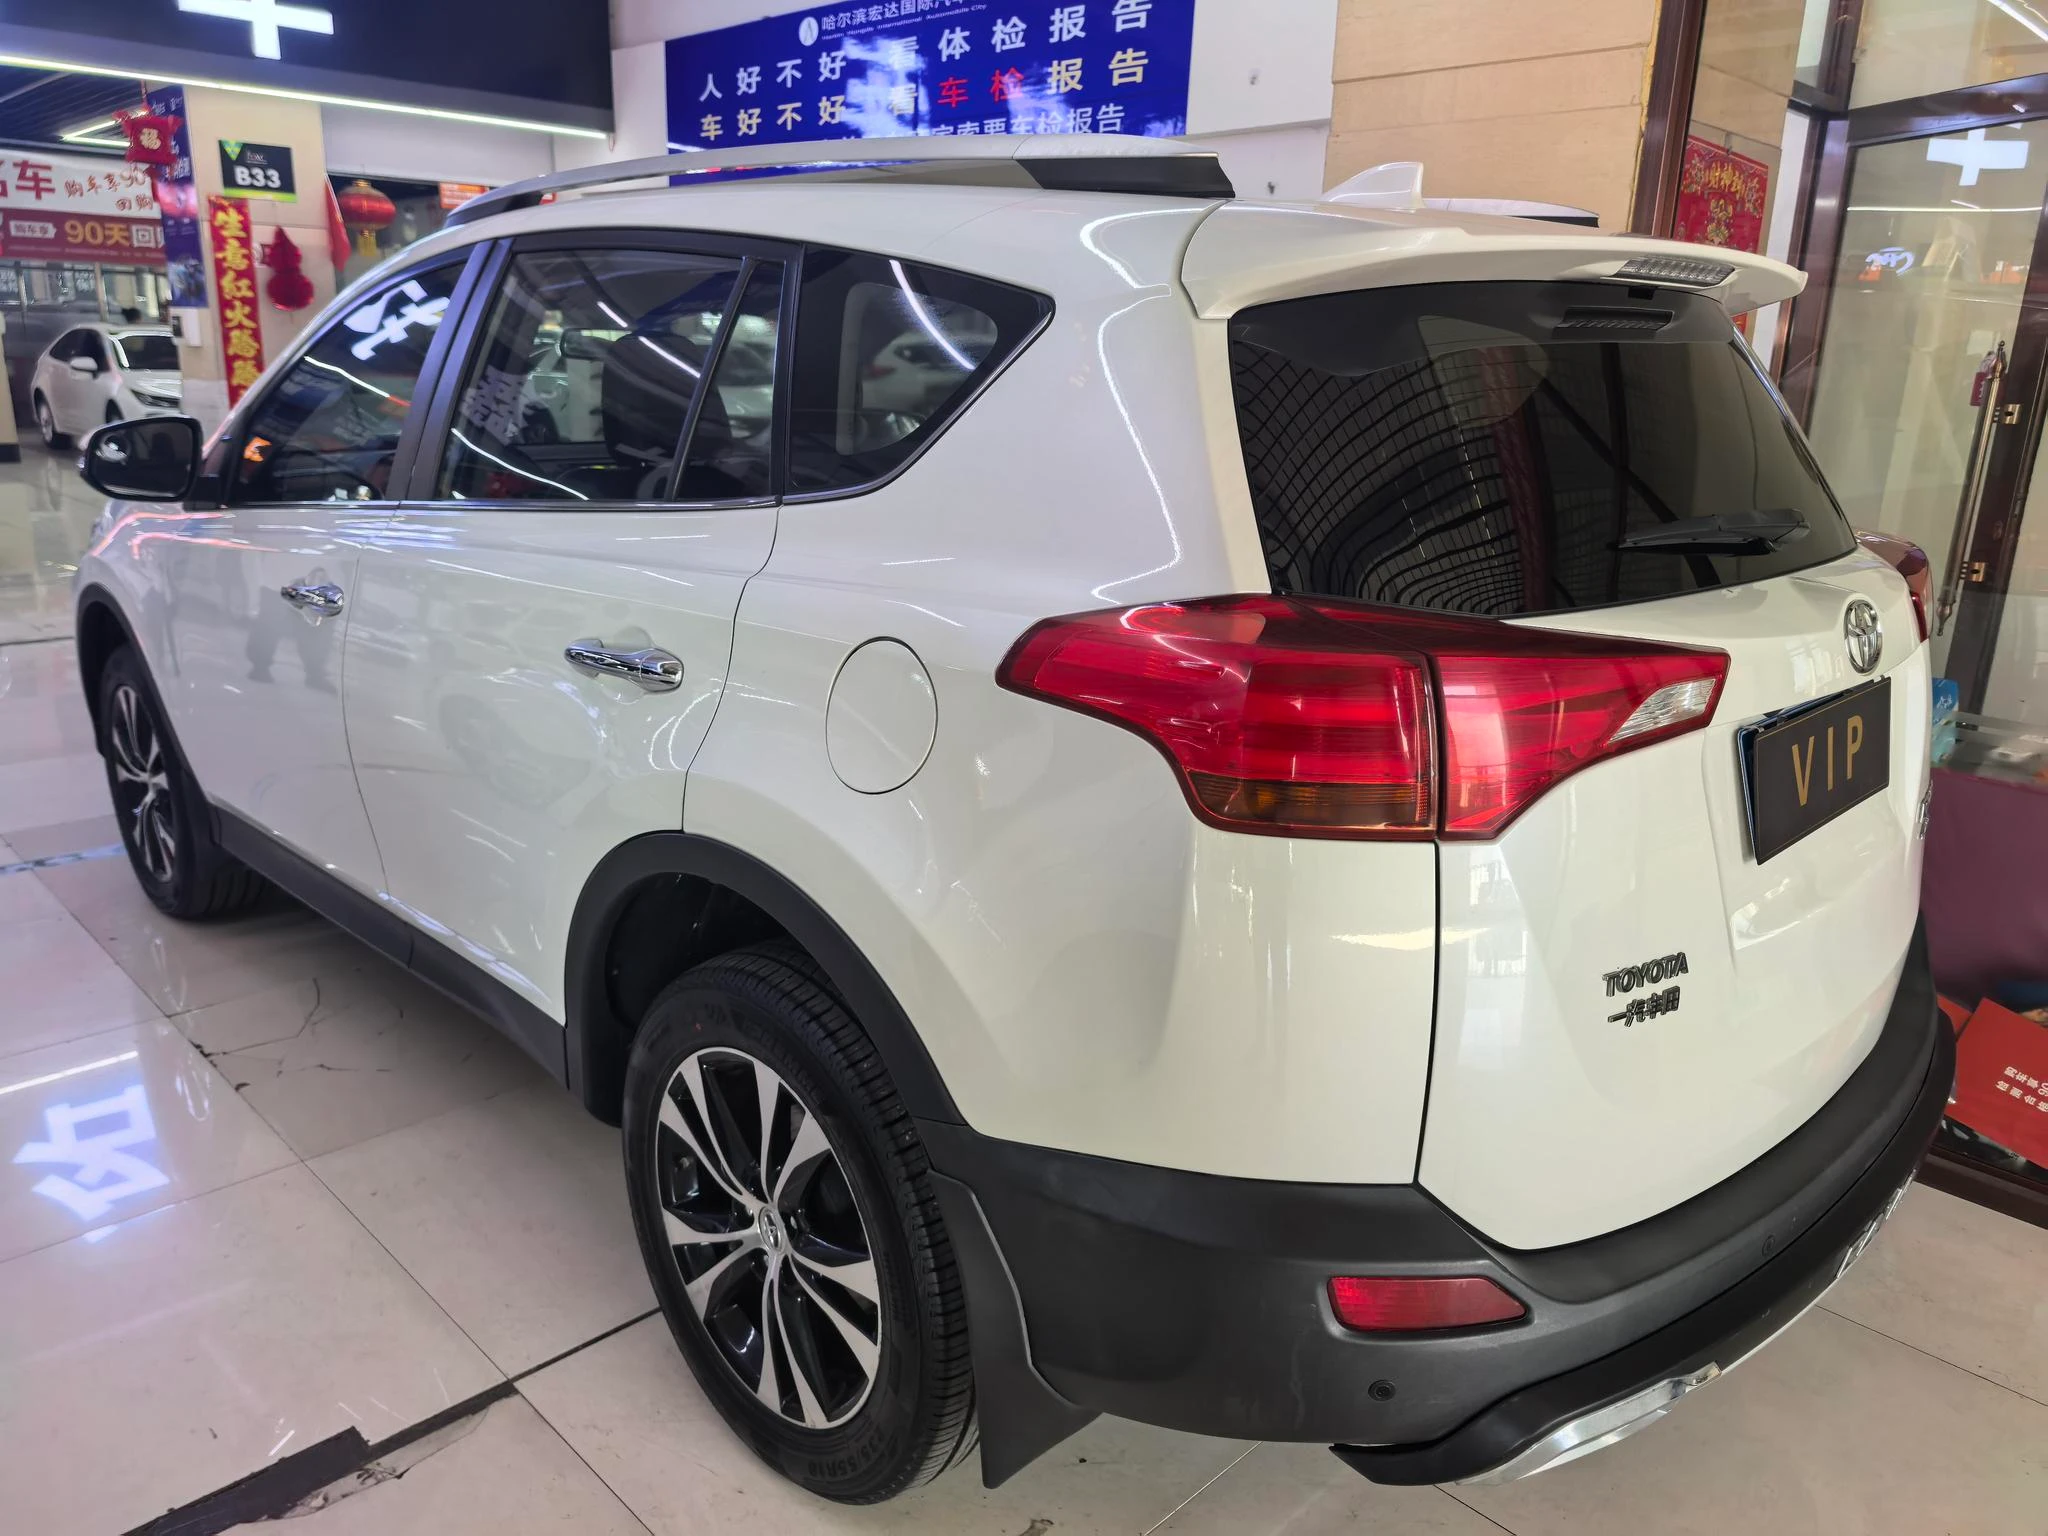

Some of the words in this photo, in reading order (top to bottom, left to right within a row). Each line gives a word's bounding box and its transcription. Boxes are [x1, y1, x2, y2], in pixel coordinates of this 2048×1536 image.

[821, 0, 963, 30] 哈尔滨宏达国际
[699, 50, 847, 102] 人好不好
[700, 95, 846, 141] 车好不好
[0, 160, 56, 200] 车
[234, 165, 281, 188] B33
[1791, 714, 1863, 807] VIP
[1602, 952, 1689, 997] TOYOTA
[1607, 986, 1681, 1027] 一汽丰田
